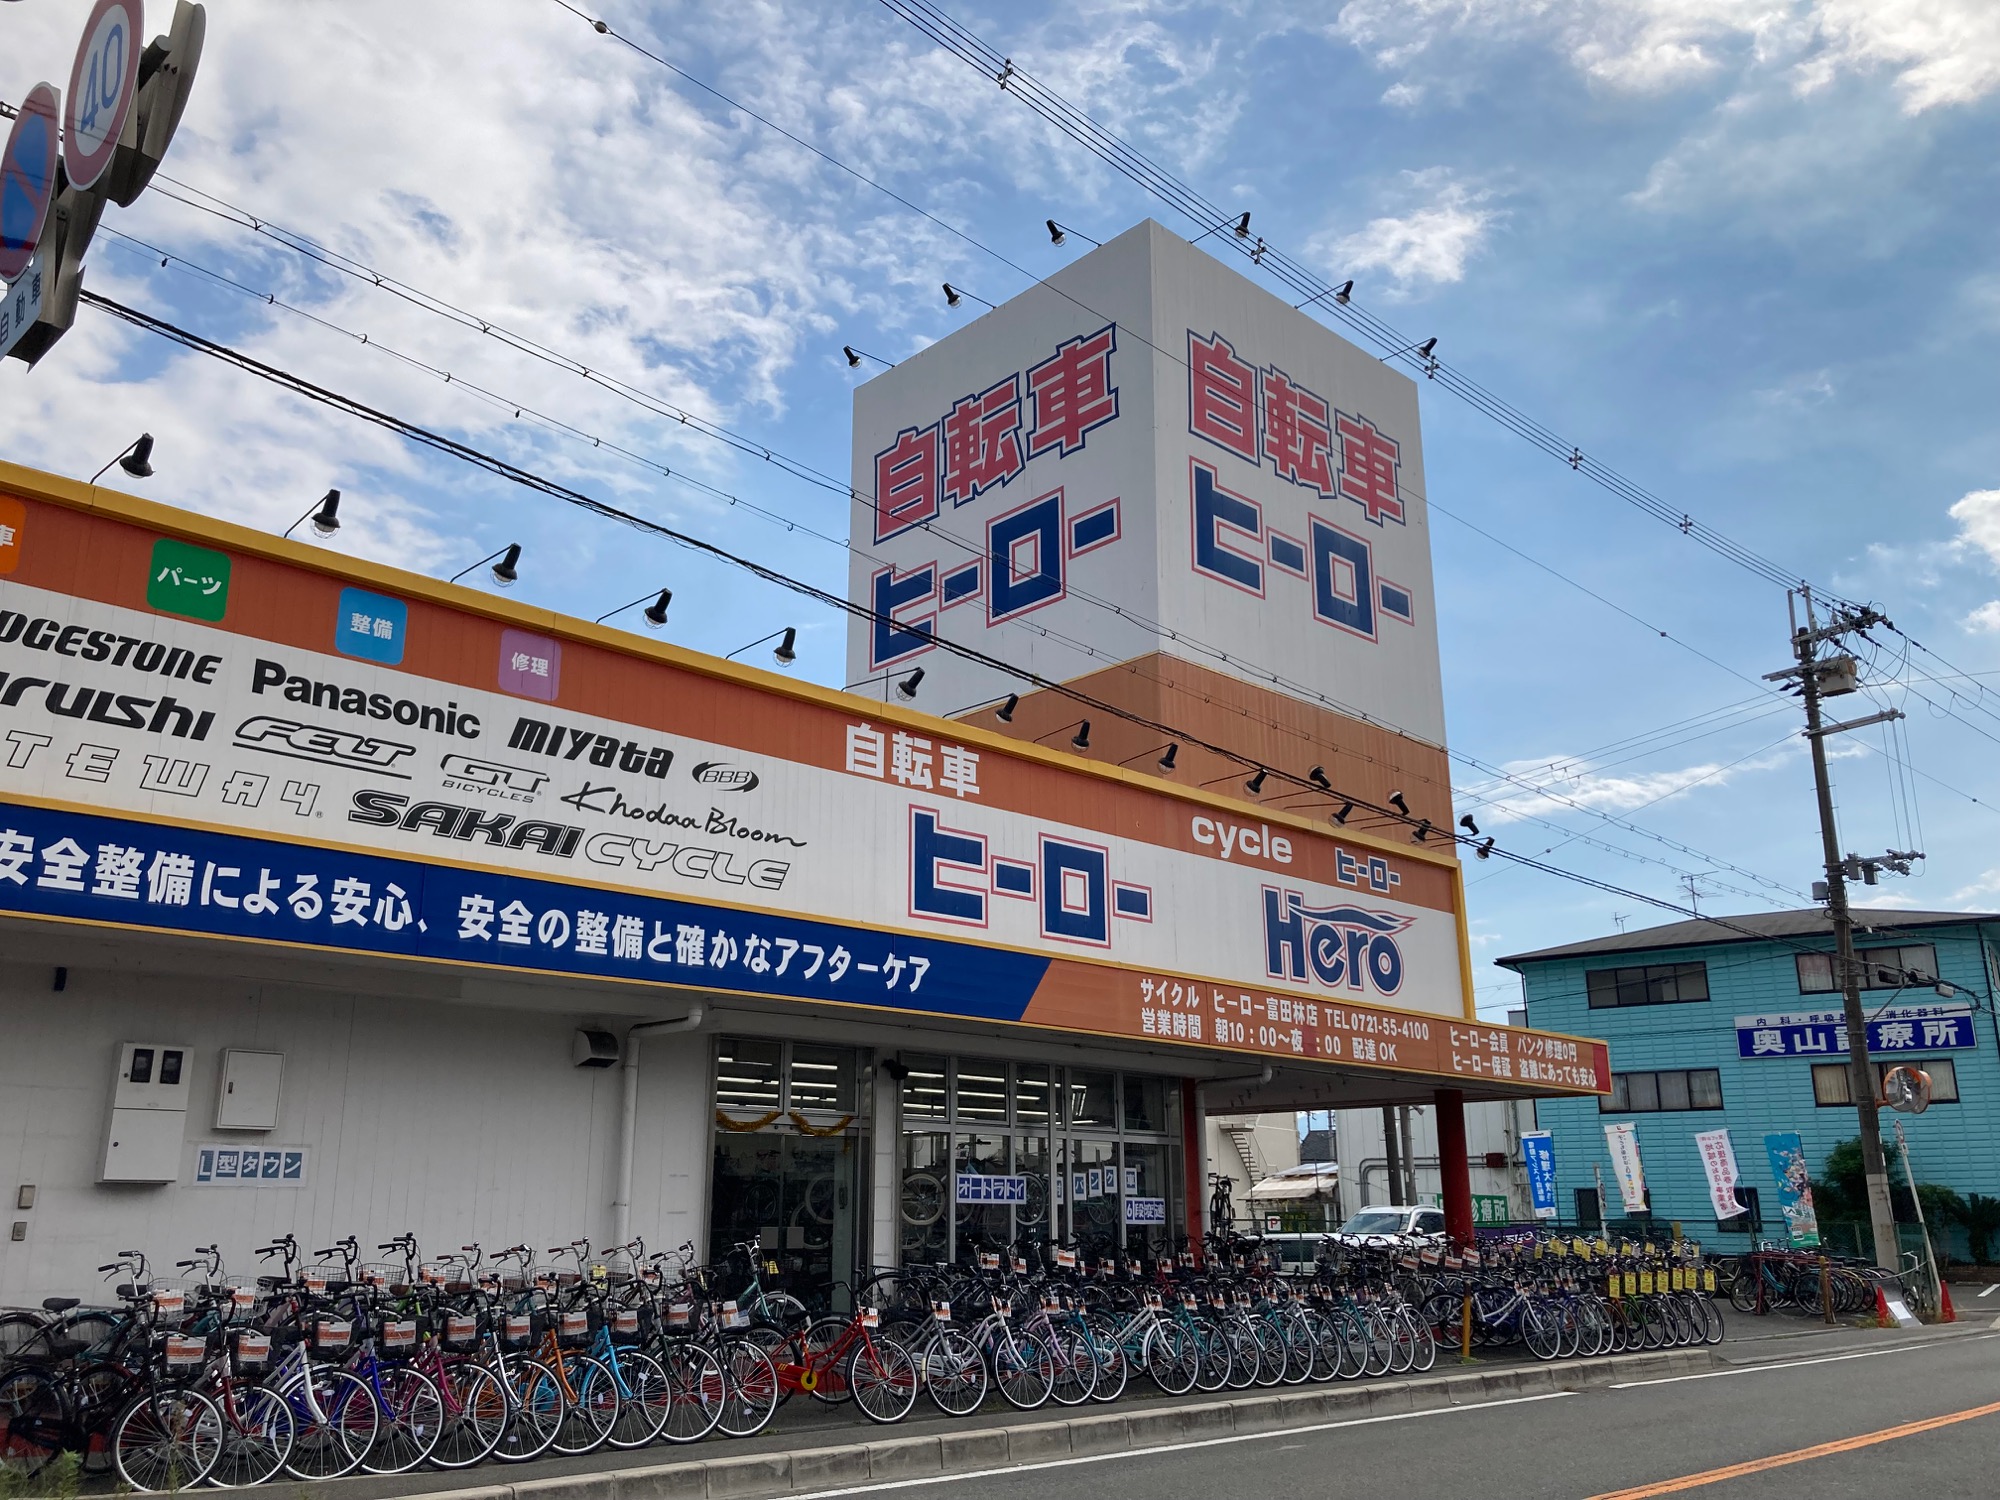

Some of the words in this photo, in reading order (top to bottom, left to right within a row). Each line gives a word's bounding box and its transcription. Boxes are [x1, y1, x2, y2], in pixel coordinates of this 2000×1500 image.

[80, 24, 123, 135] 40
[874, 321, 1119, 546] 自転車
[1187, 328, 1407, 526] 自転車
[1189, 455, 1415, 644] ヒーロー
[157, 566, 222, 595] パーツ
[869, 485, 1121, 672] ヒーロー
[350, 612, 393, 640] 整備
[511, 651, 549, 678] 修理
[251, 658, 481, 740] Panasonic
[235, 715, 417, 767] FELT
[844, 722, 981, 798] 自転車
[440, 753, 550, 793] GT
[442, 779, 535, 804] BICYCLES
[348, 789, 586, 859] SAKAI
[585, 832, 791, 891] CYCLE
[560, 781, 702, 830] Khodaa
[704, 806, 808, 848] Bloom
[1191, 815, 1293, 865] cycle
[908, 803, 1153, 950] ヒーロー
[1335, 846, 1402, 894] ヒーロー
[457, 894, 931, 993] 安全の整備と確かなアフターケア
[1261, 883, 1418, 997] Hero
[1140, 978, 1200, 1009] サイクル
[1213, 989, 1318, 1027] ヒーロー富田林店
[1141, 1007, 1202, 1040] 営業時間
[1449, 1026, 1509, 1054] ヒーロー会員
[1452, 1051, 1512, 1077] ヒーロー保証
[1518, 1058, 1597, 1088] 盗難にあっても安心
[199, 1154, 301, 1176] L型タウン
[1270, 1217, 1278, 1229] P
